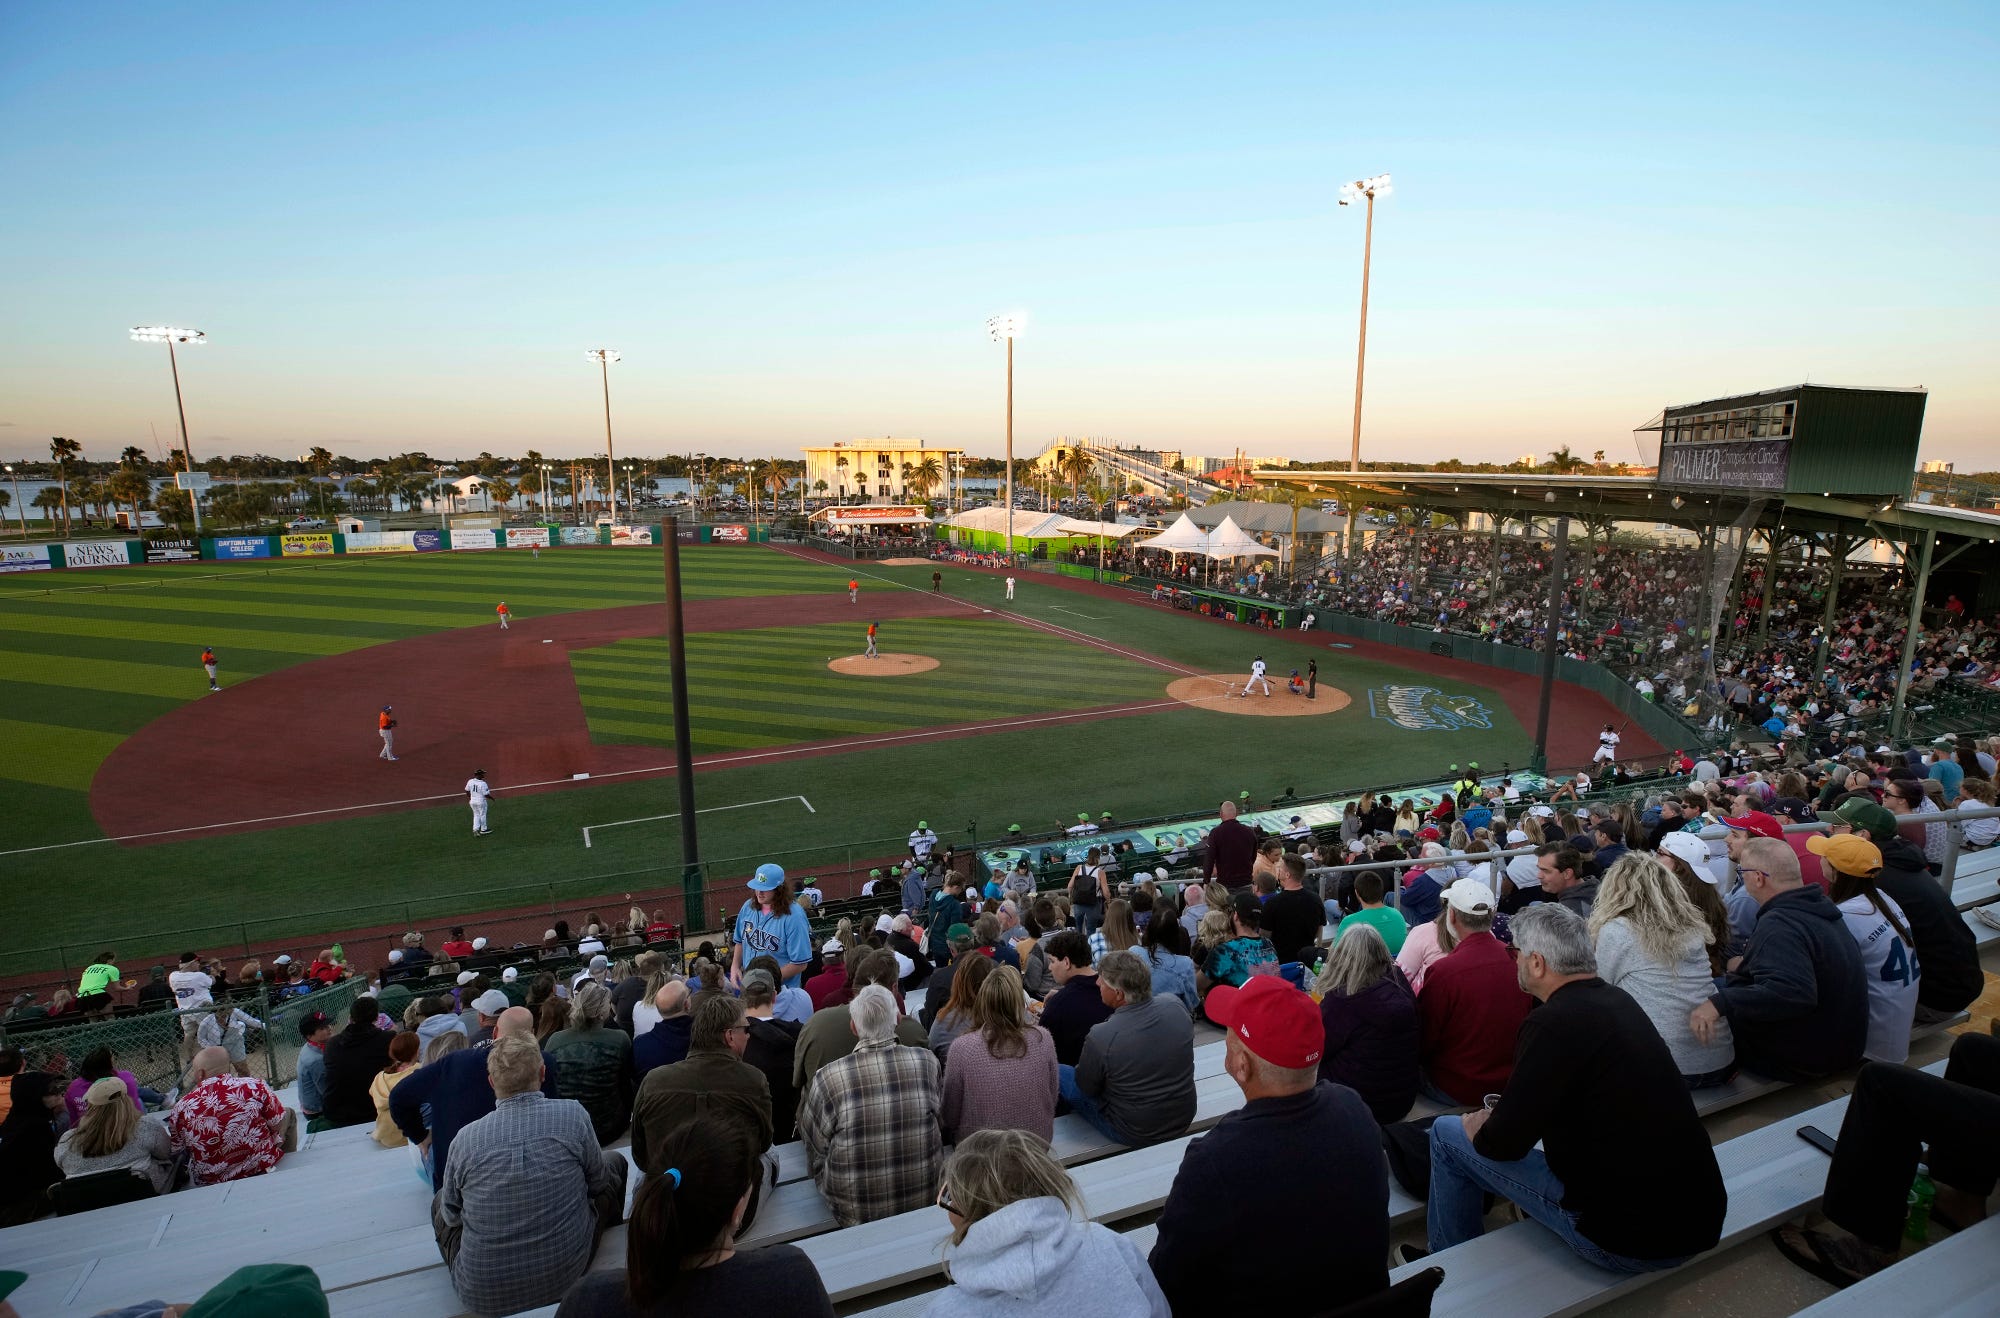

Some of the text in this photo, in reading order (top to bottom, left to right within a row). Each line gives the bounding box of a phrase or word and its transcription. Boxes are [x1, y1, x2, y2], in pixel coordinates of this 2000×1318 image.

[1672, 449, 1720, 479] PALMER
[712, 527, 744, 536] DEX
[69, 554, 127, 566] JOURNAL
[473, 784, 478, 792] 11
[743, 920, 781, 952] RAYS
[1868, 923, 1887, 942] STAND
